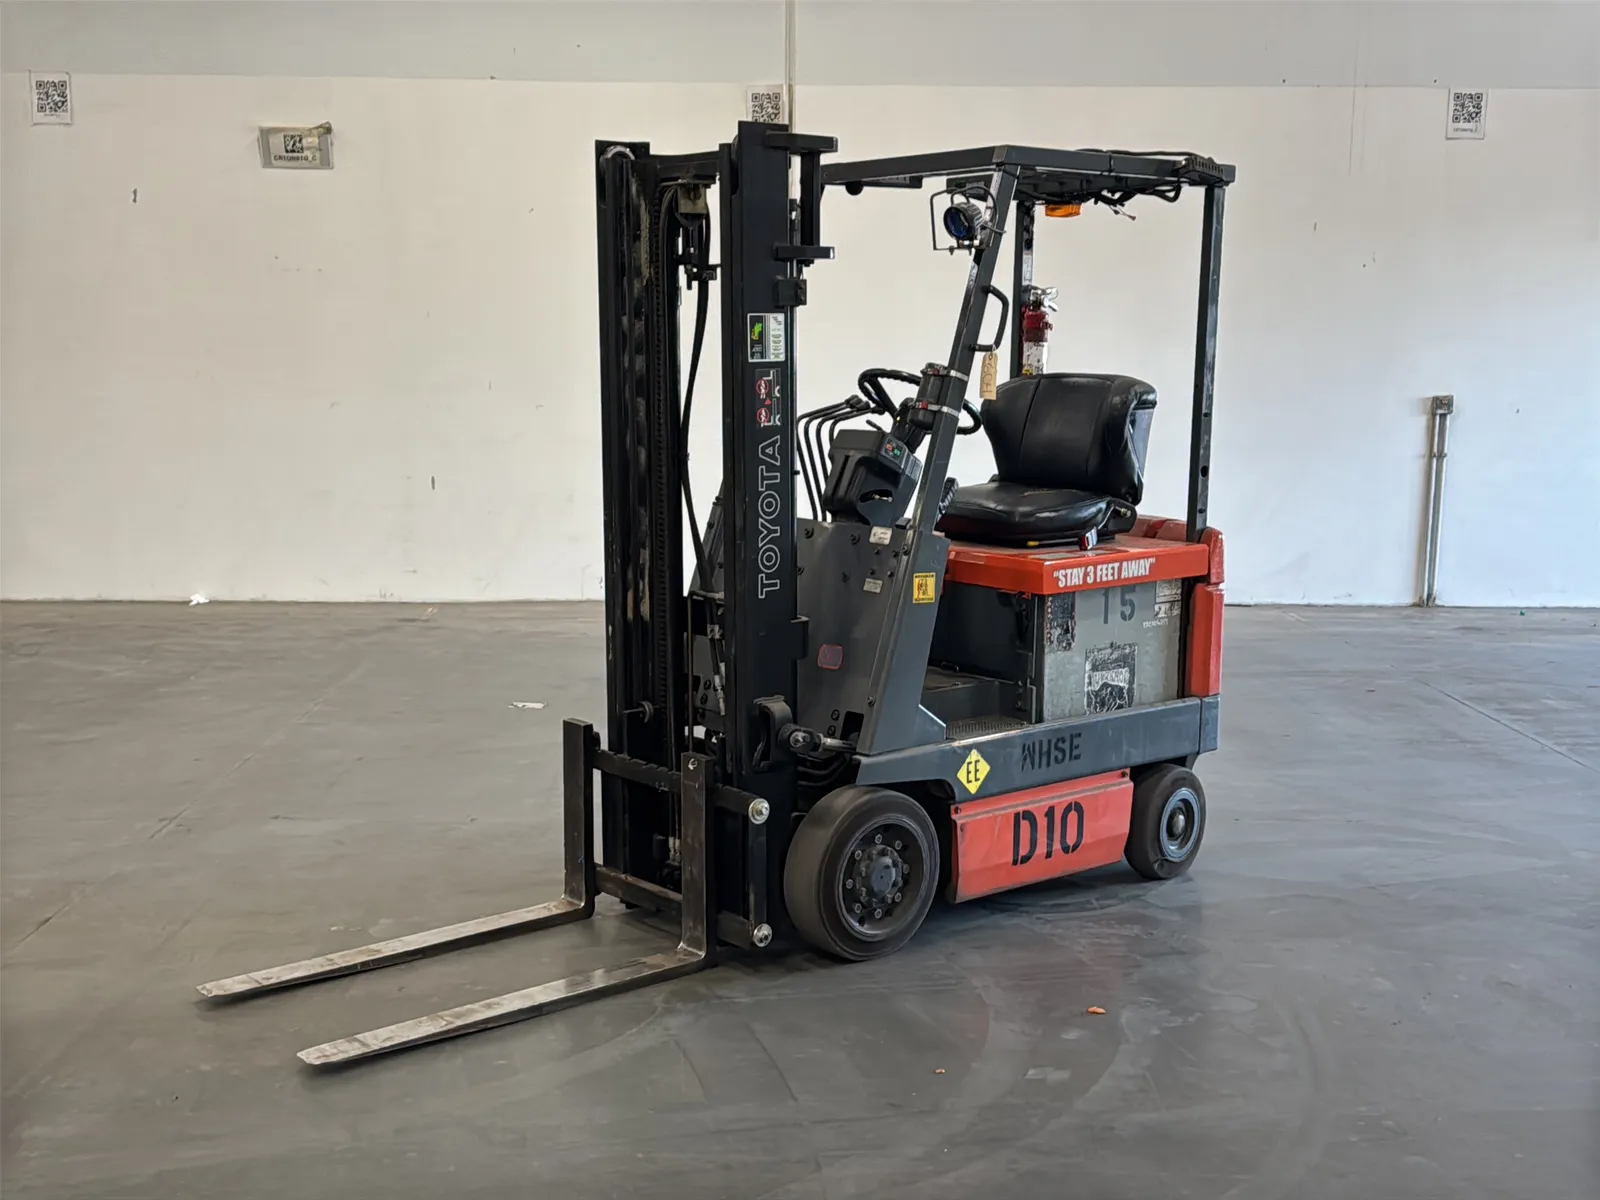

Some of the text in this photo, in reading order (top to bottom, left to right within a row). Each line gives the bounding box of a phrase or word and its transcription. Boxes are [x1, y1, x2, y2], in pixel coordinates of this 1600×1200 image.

[758, 434, 781, 599] TOYOTA
[1053, 557, 1156, 588] “STAY 3 FEET AWAY”
[1021, 732, 1082, 771] WHSE
[966, 759, 981, 784] EE
[1011, 801, 1085, 866] D10
